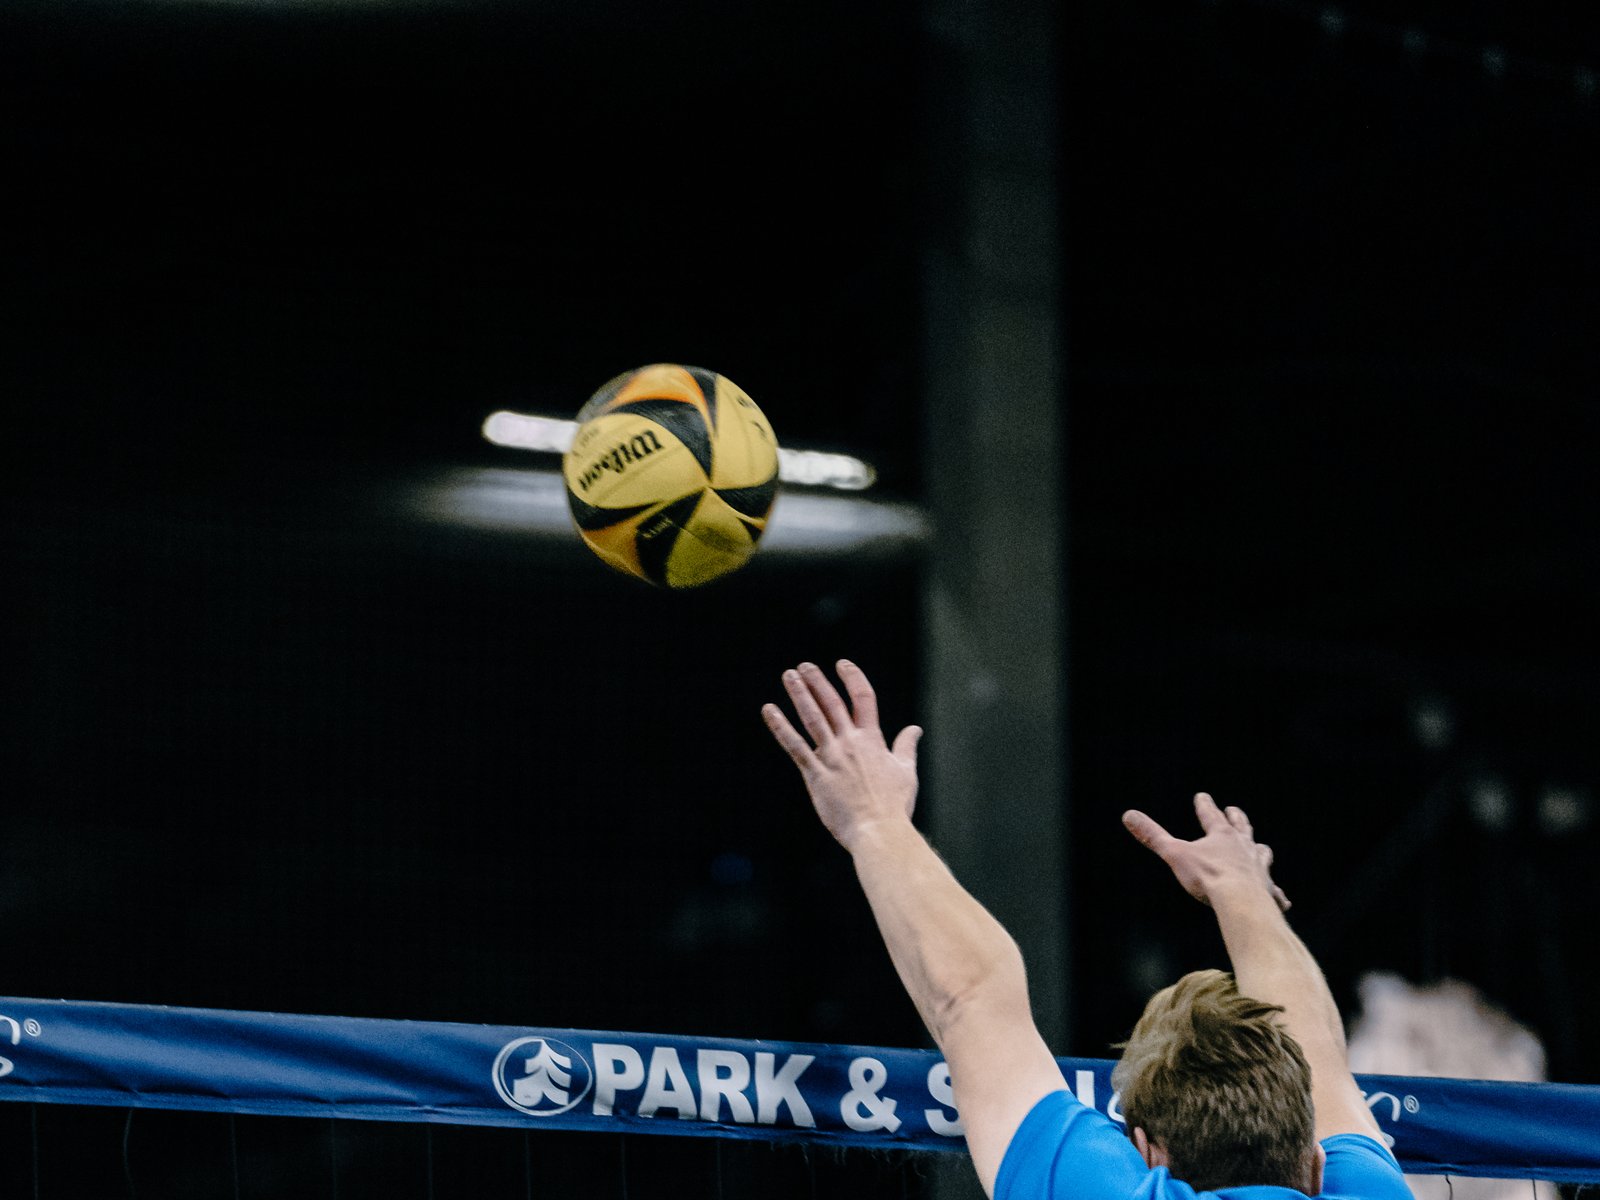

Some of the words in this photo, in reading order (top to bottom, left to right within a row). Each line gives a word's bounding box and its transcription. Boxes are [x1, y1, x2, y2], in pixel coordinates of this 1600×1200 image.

[577, 430, 664, 492] Wilson
[592, 1043, 817, 1129] PARK
[840, 1057, 902, 1133] &
